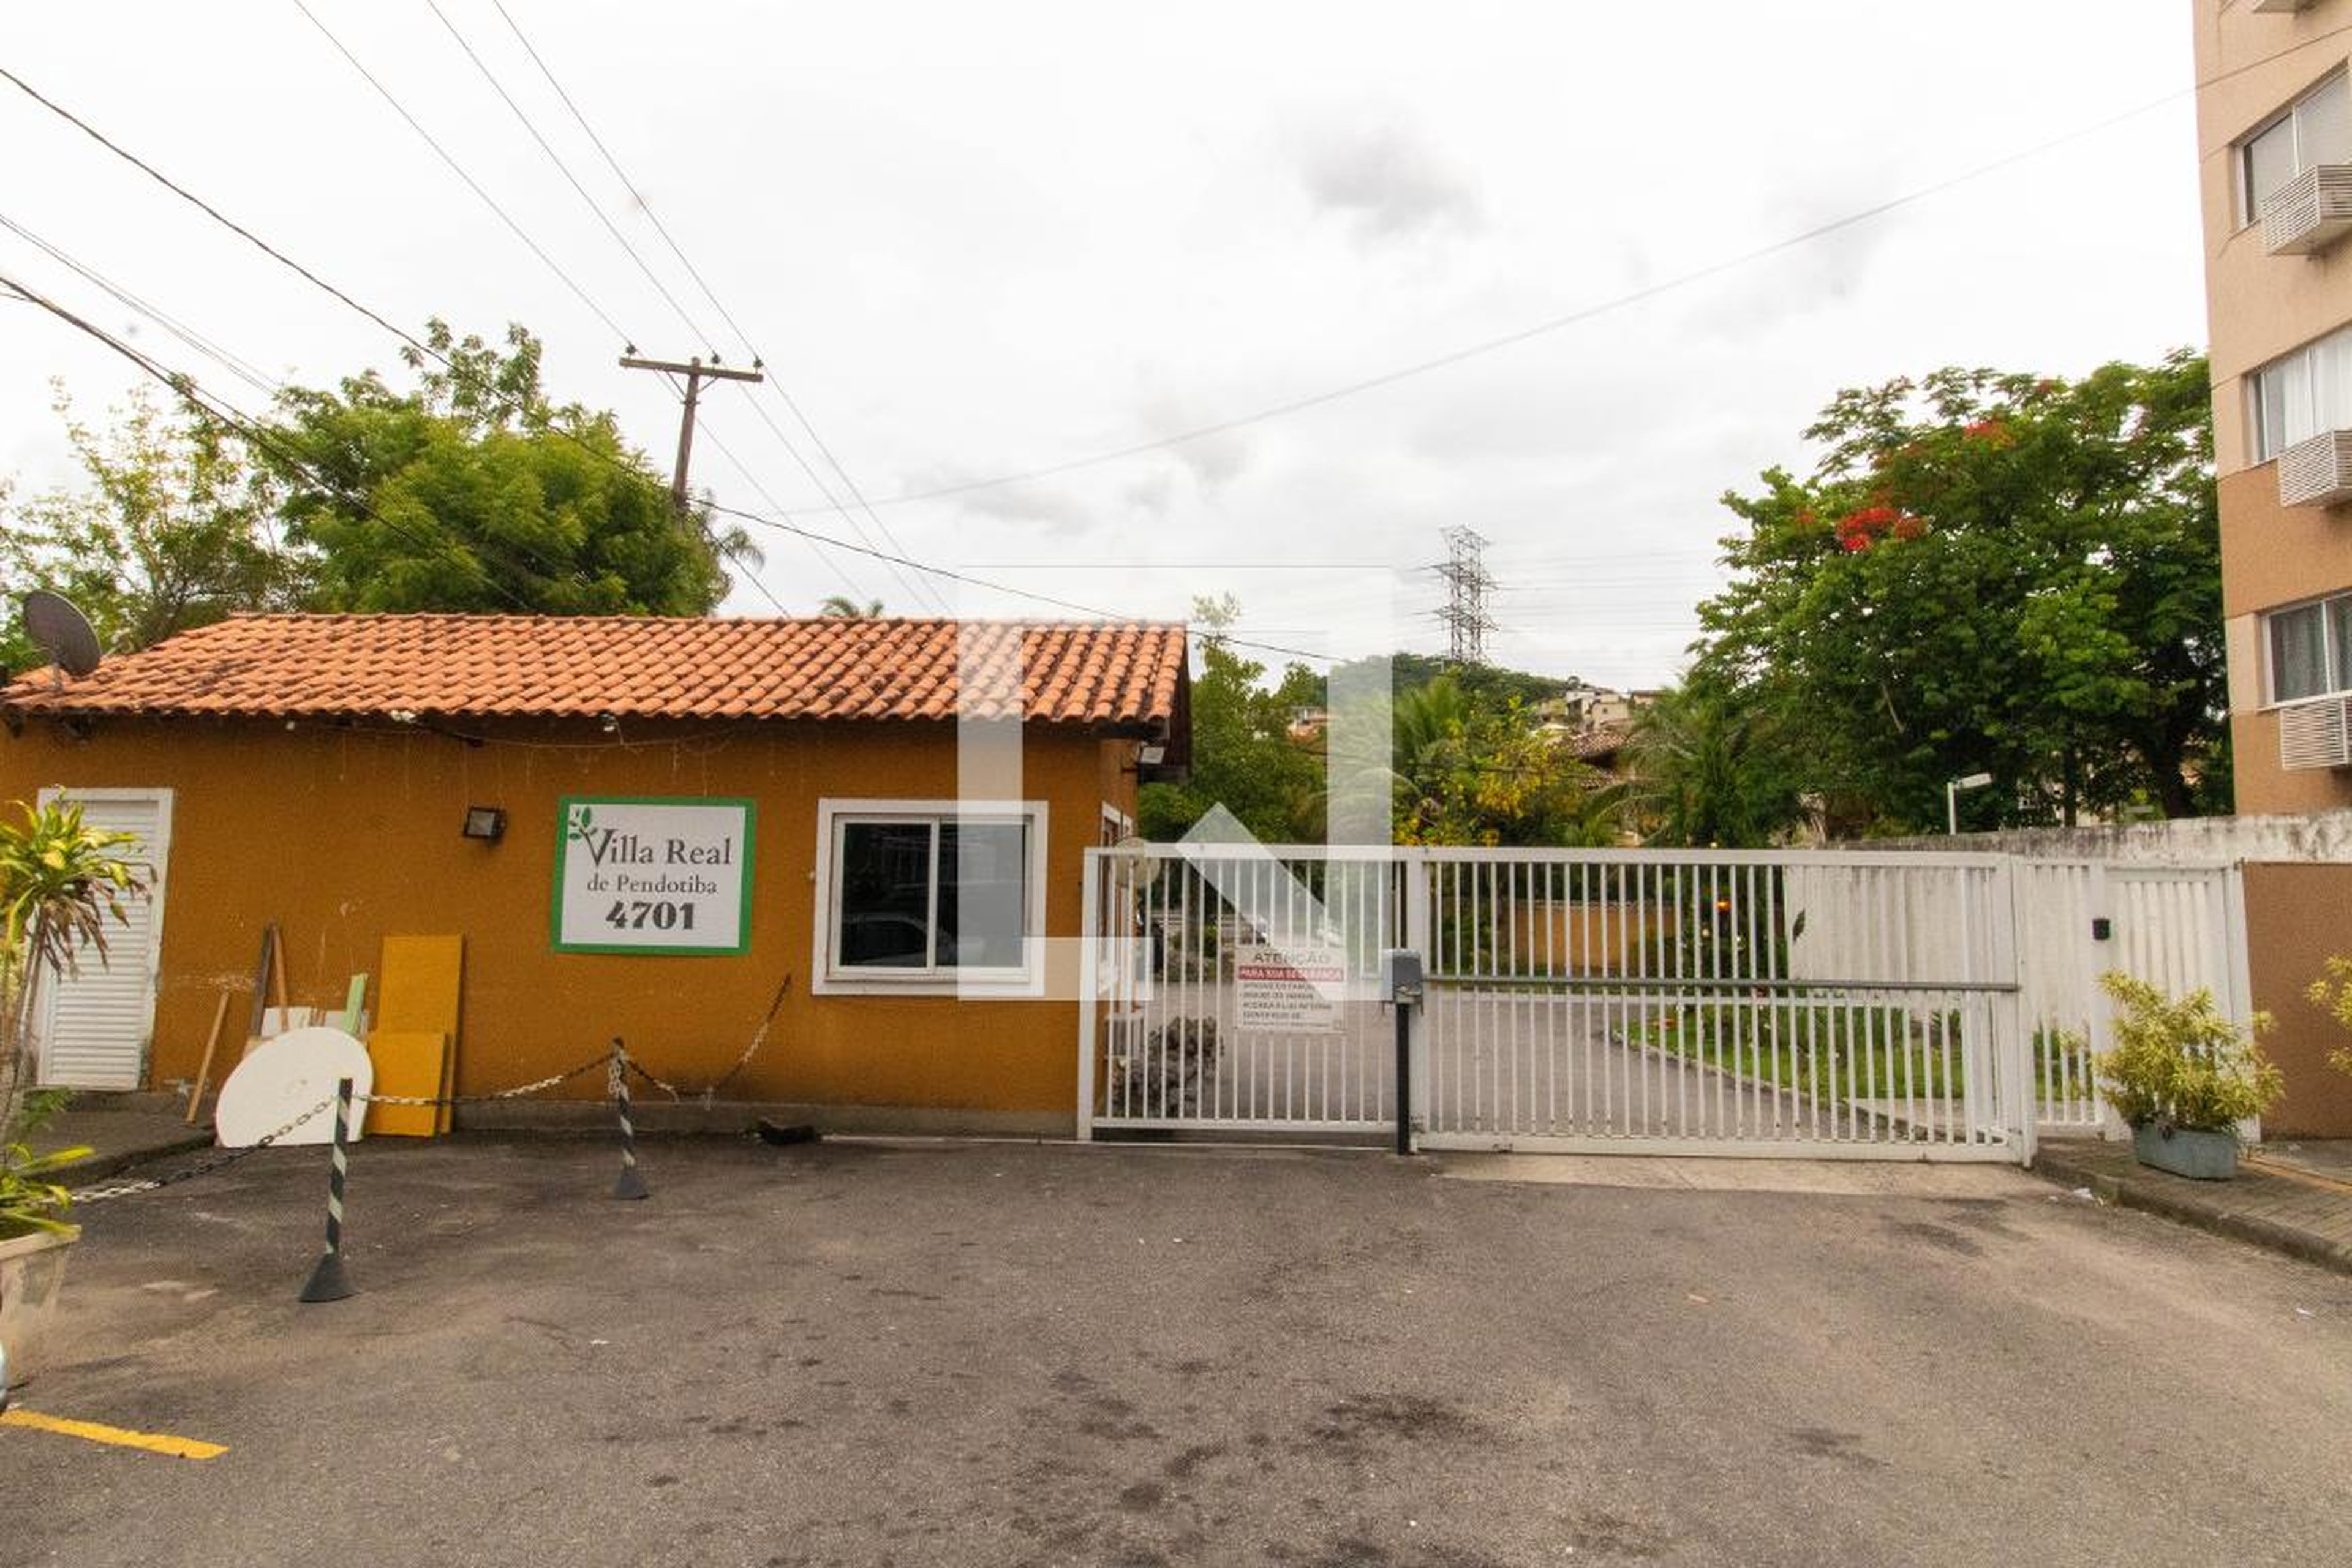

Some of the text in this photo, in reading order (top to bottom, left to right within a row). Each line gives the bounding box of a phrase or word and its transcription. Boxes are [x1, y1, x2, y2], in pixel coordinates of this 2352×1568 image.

[580, 829, 731, 867] Villa Real
[587, 873, 717, 894] de Pendotiba
[606, 901, 695, 930] 4701
[1254, 951, 1331, 965] ATENÇÃO
